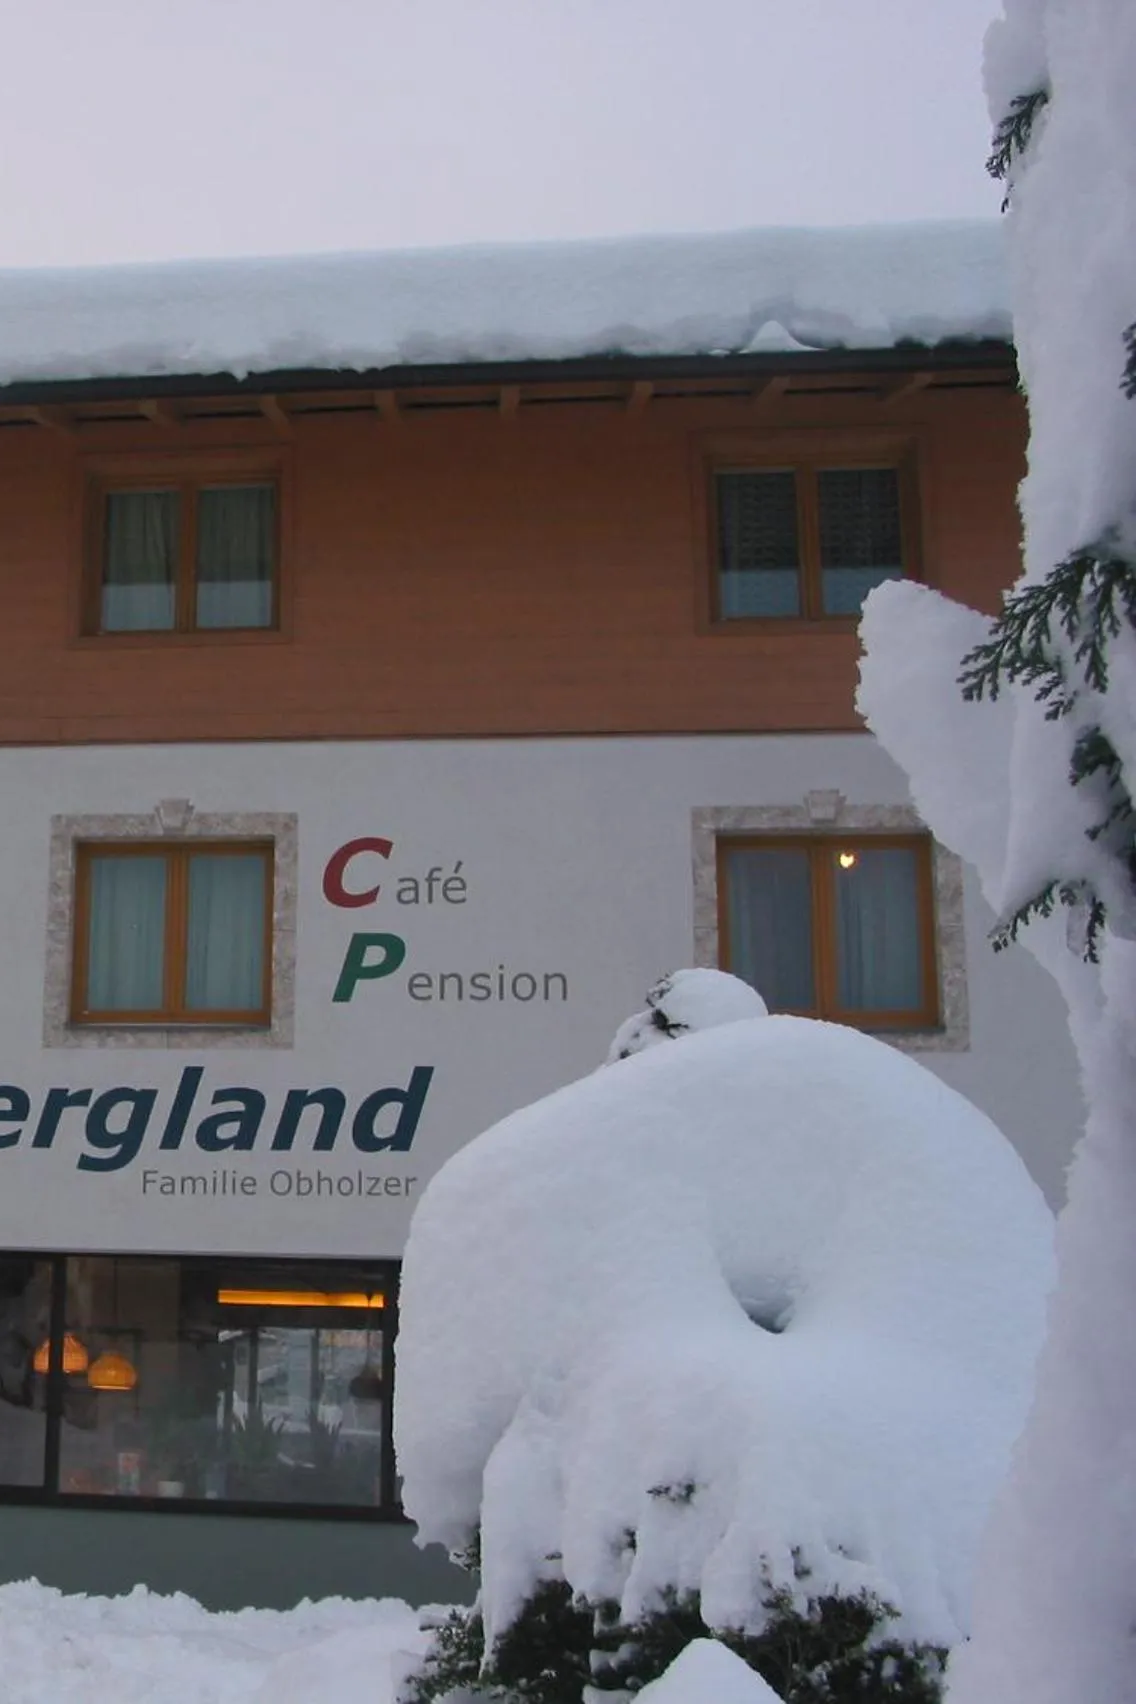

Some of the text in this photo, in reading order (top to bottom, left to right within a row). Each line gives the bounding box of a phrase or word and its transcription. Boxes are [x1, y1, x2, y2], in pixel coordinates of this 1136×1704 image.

[322, 836, 468, 909] Café
[331, 932, 569, 1003] Pension
[142, 1169, 418, 1197] Familie Obholzer
